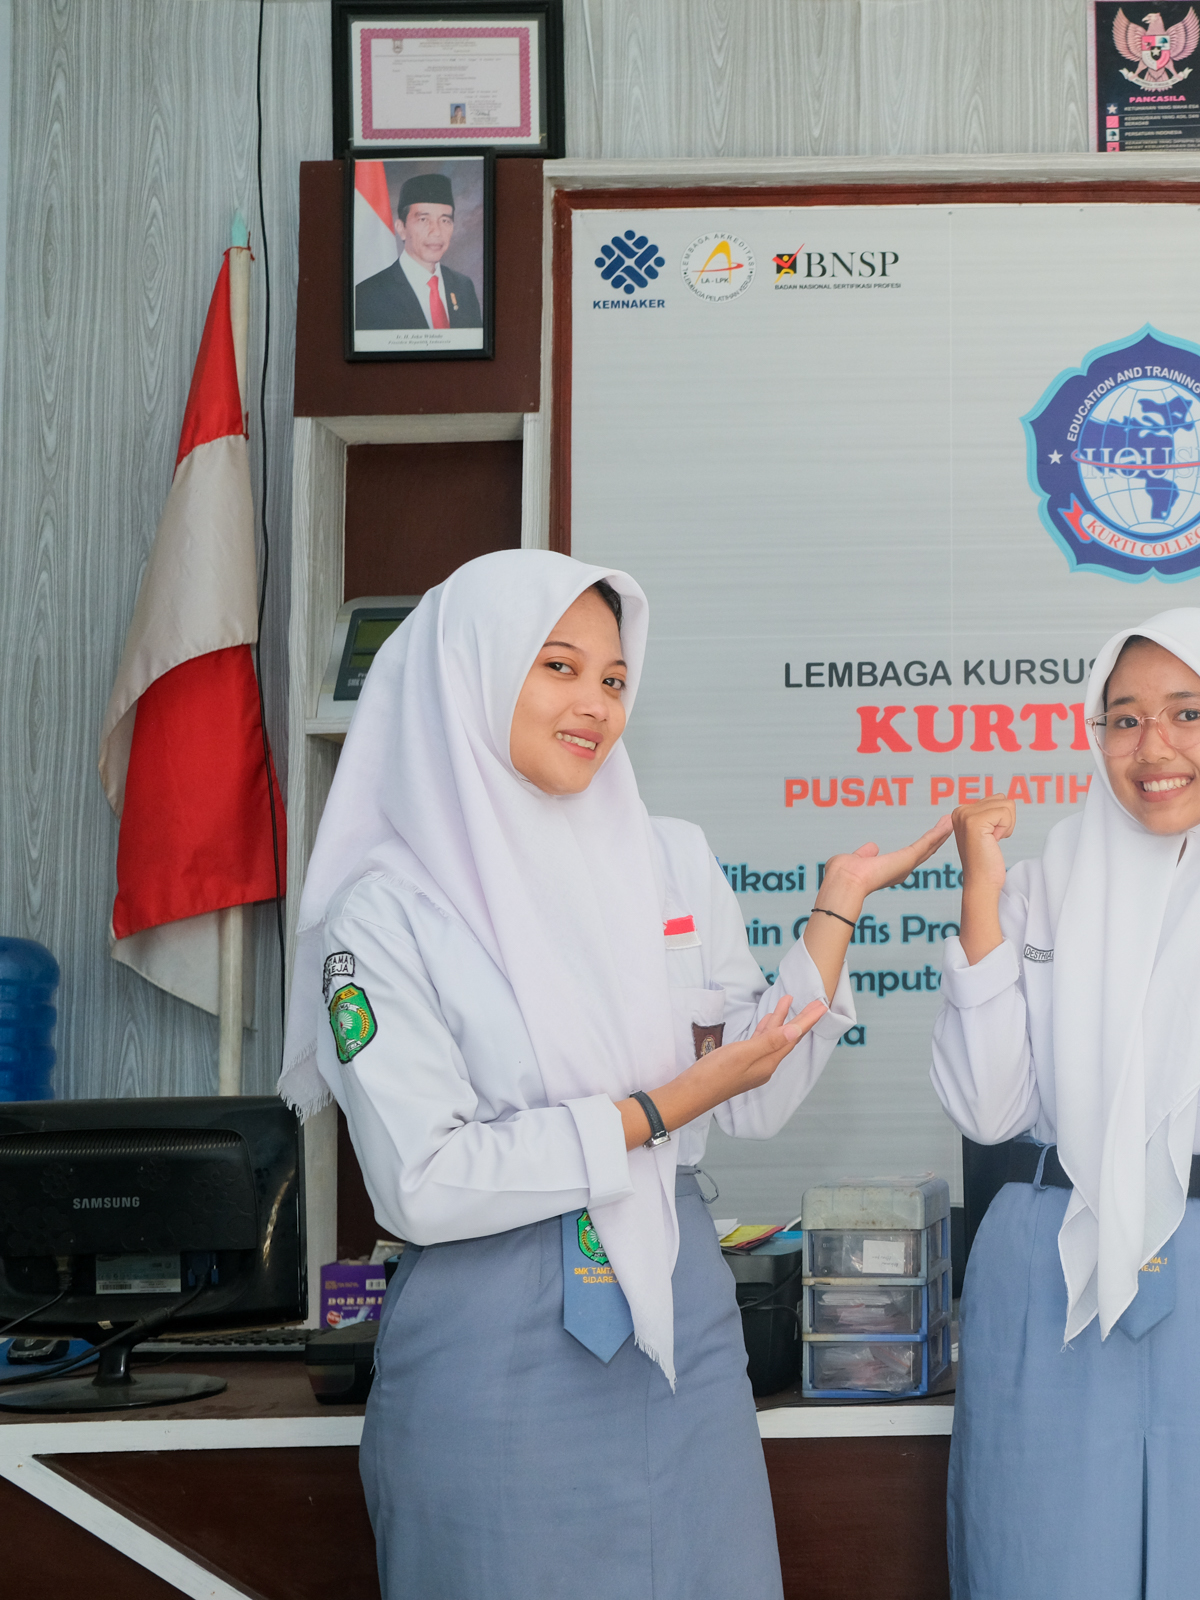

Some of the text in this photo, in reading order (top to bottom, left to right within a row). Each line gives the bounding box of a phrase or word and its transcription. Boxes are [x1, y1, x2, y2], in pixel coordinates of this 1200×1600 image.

[1129, 95, 1186, 103] PANCASILA
[804, 251, 900, 278] BNSP
[593, 299, 665, 309] KEMNAKER
[1067, 377, 1115, 442] EDUCATION
[1116, 366, 1143, 384] AND
[1087, 519, 1136, 554] KURTI
[784, 660, 952, 688] LEMBAGA
[784, 775, 914, 808] PUSAT
[929, 772, 1093, 806] PELATIH
[73, 1196, 140, 1209] SAMSUNG
